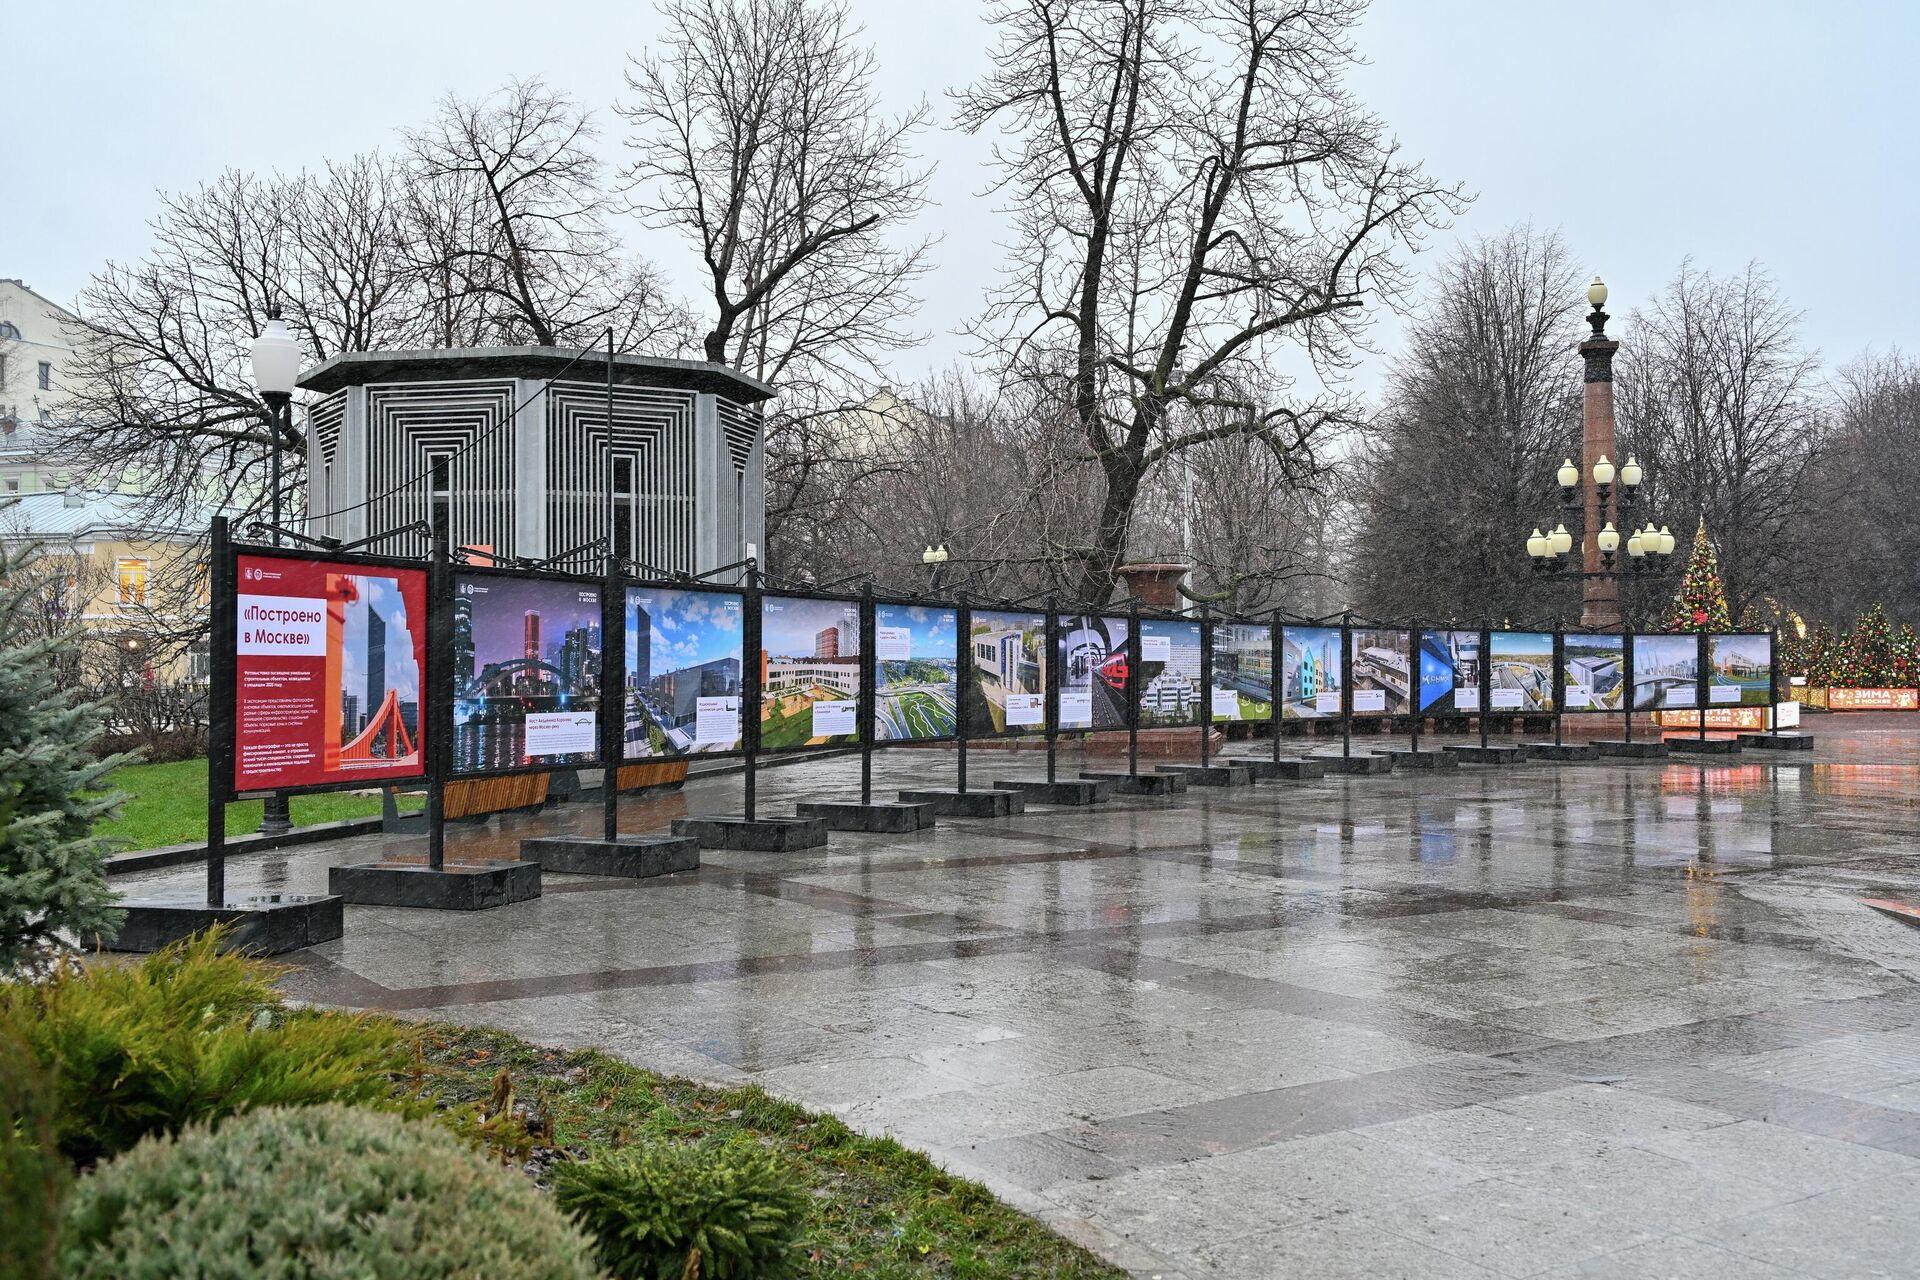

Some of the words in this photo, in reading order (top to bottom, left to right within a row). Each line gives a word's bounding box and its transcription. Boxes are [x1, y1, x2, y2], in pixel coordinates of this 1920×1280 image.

[244, 606, 321, 625] «Построено
[244, 632, 251, 643] в
[254, 629, 310, 645] Москве»
[1855, 690, 1891, 699] ЗИМА
